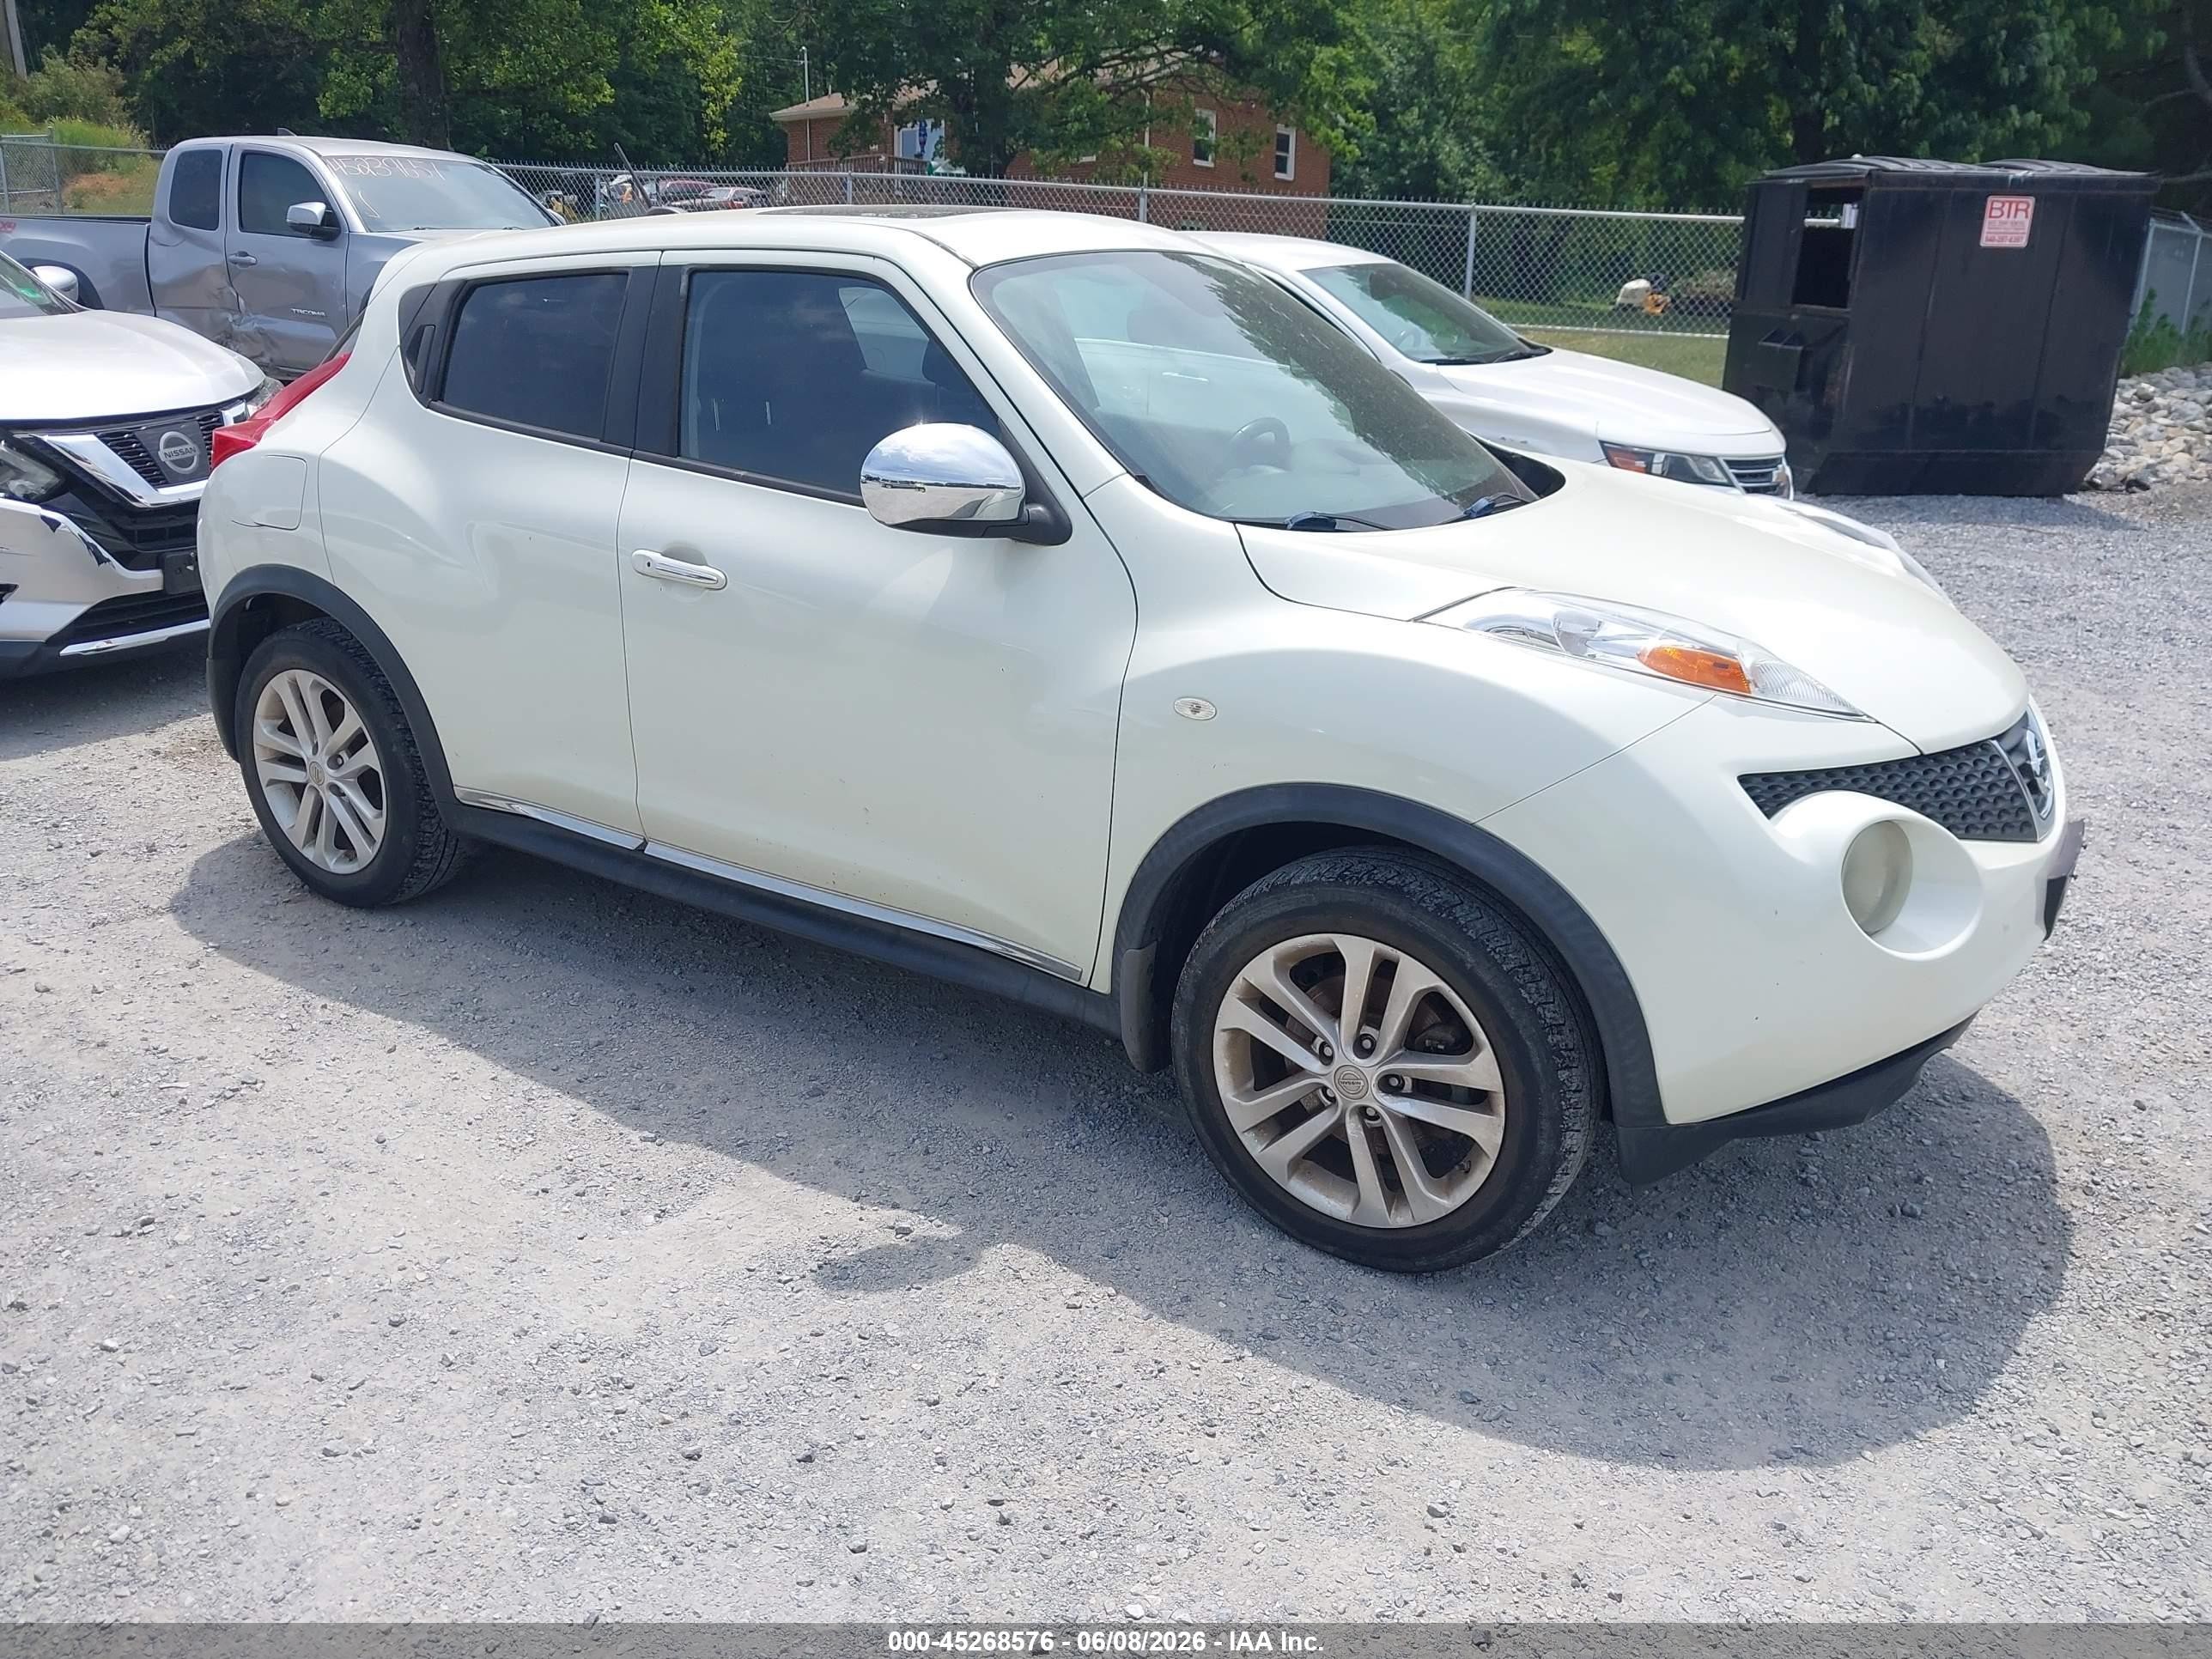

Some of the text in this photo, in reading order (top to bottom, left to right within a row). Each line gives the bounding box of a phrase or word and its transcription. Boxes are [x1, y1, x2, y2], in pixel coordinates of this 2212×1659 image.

[1988, 200, 2030, 219] BTR
[290, 307, 325, 317] TACOMA
[164, 447, 197, 459] NISSAN
